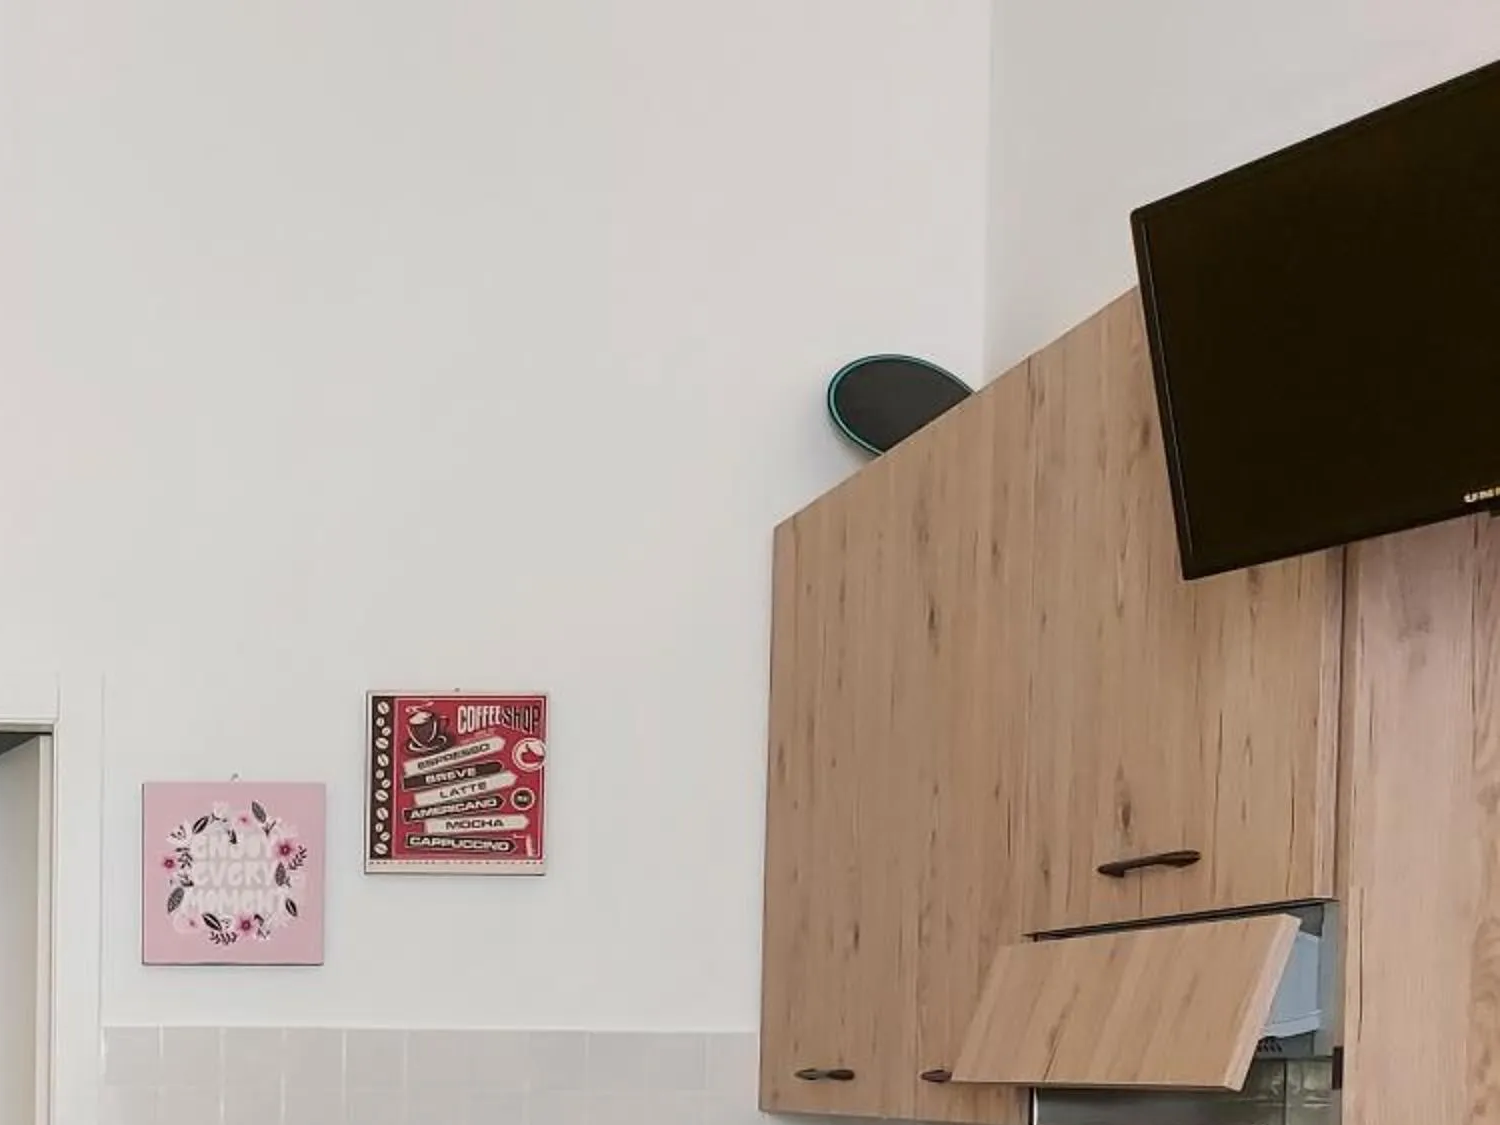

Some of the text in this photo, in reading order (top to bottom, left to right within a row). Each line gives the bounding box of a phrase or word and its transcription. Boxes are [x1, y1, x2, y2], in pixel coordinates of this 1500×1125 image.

[457, 704, 541, 735] COFFEE SHOP
[417, 742, 491, 770] ESPRESSO
[425, 766, 477, 785] BREVE
[439, 781, 487, 799] LATTE
[410, 798, 498, 820] AMERICANO
[445, 819, 505, 831] MOCHA
[409, 836, 510, 852] CAPPUCCINO
[193, 860, 278, 887] EVERY
